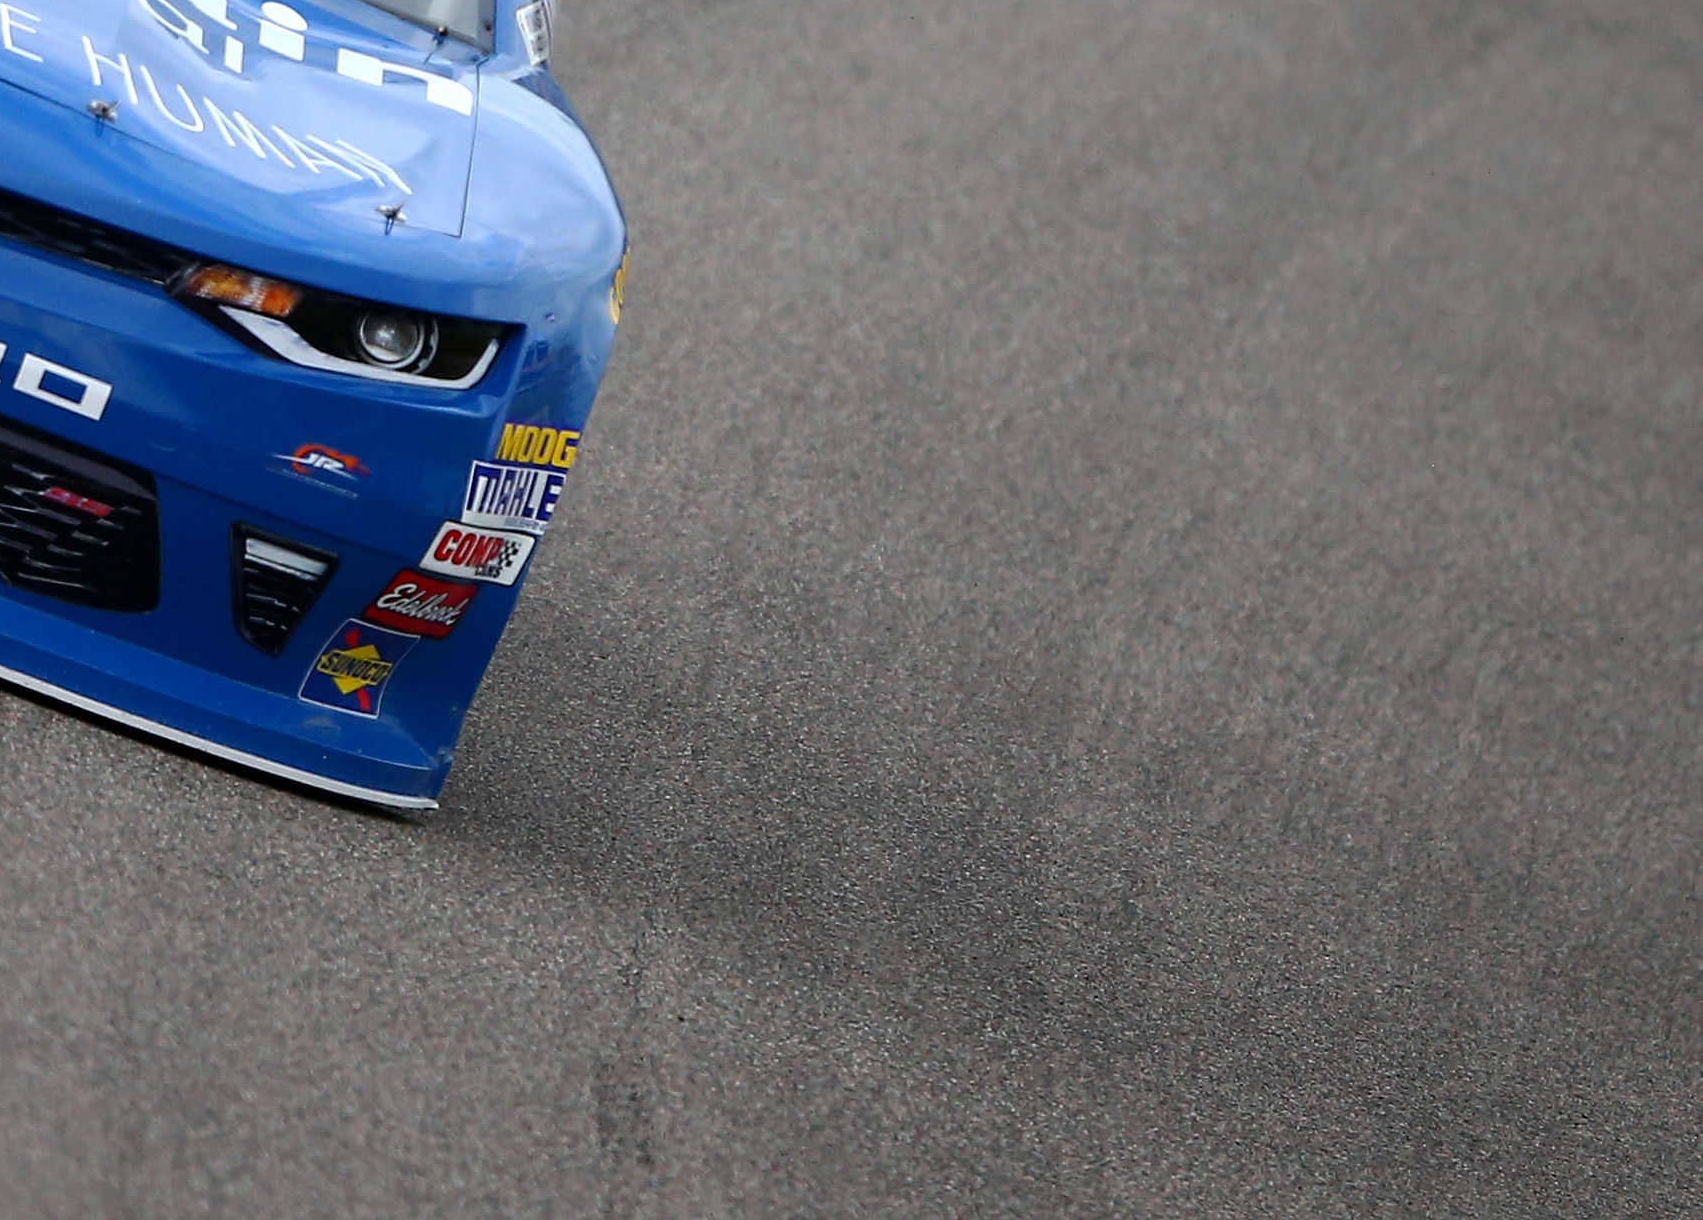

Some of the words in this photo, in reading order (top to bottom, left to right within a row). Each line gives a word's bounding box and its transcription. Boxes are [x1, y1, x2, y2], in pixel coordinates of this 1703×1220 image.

[83, 35, 412, 195] HUMAN
[496, 423, 580, 468] MOOG
[466, 464, 565, 522] MAHLE
[434, 529, 506, 568] COMP
[321, 651, 390, 682] SUNOCO
